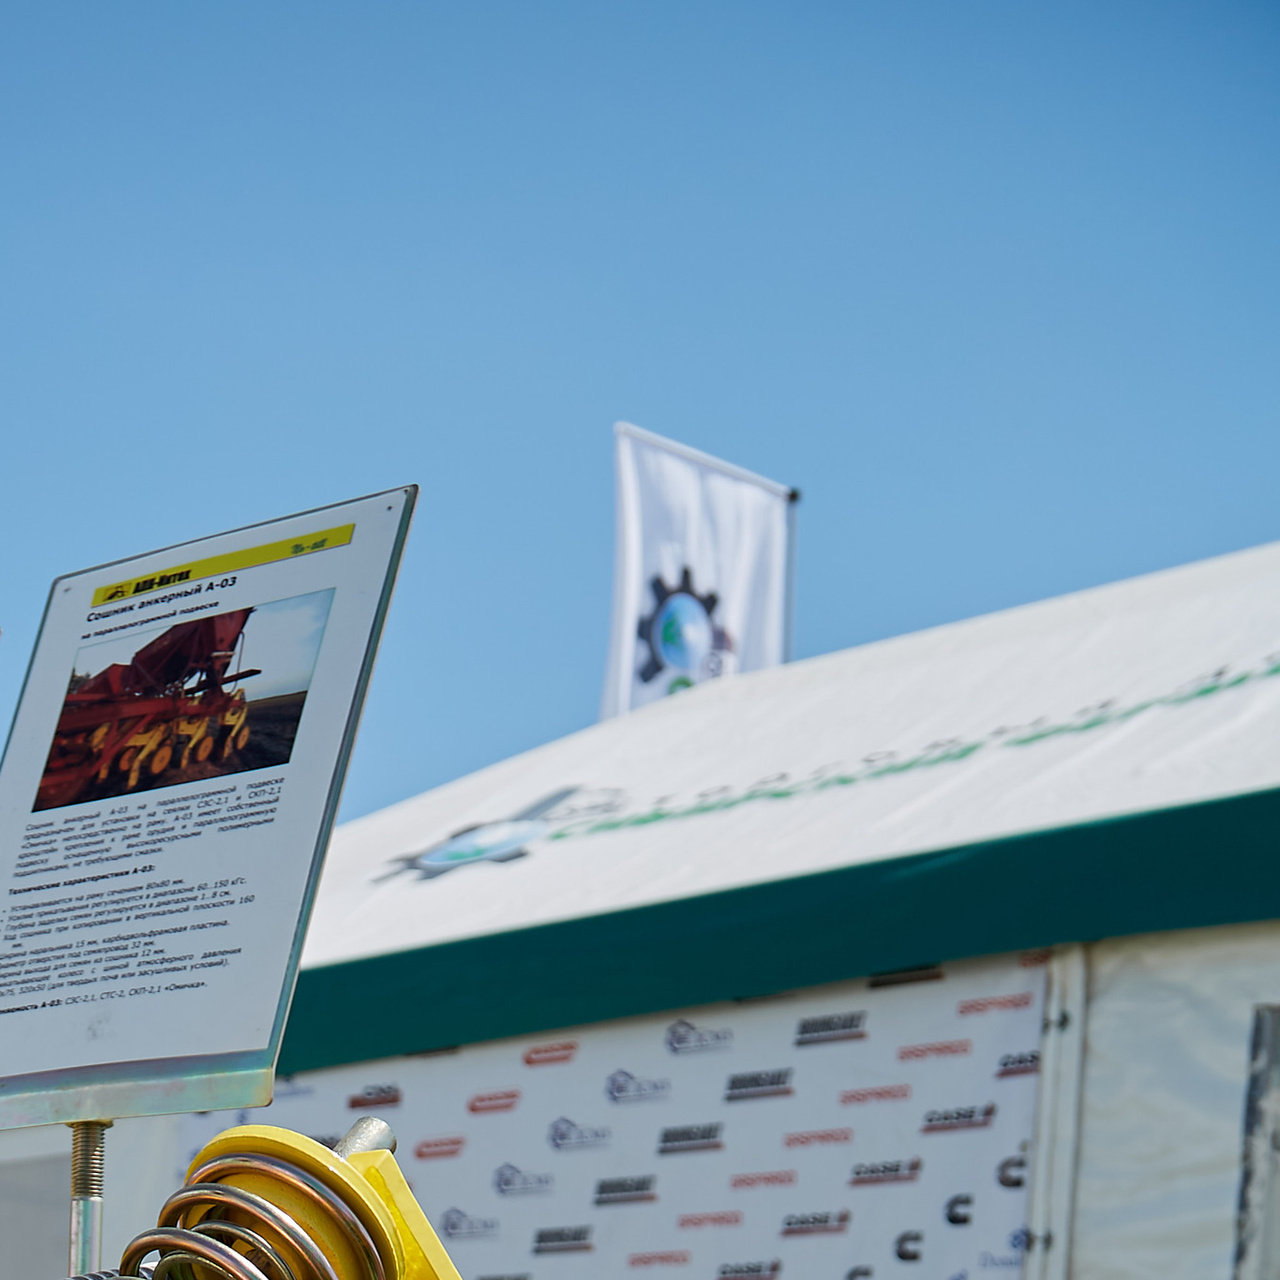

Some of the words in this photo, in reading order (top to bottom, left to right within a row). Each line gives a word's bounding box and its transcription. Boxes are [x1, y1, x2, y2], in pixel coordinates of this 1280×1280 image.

[86, 604, 134, 622] Сошник
[138, 584, 201, 608] анкерный
[205, 576, 236, 591] А-03
[999, 1052, 1040, 1068] CAS
